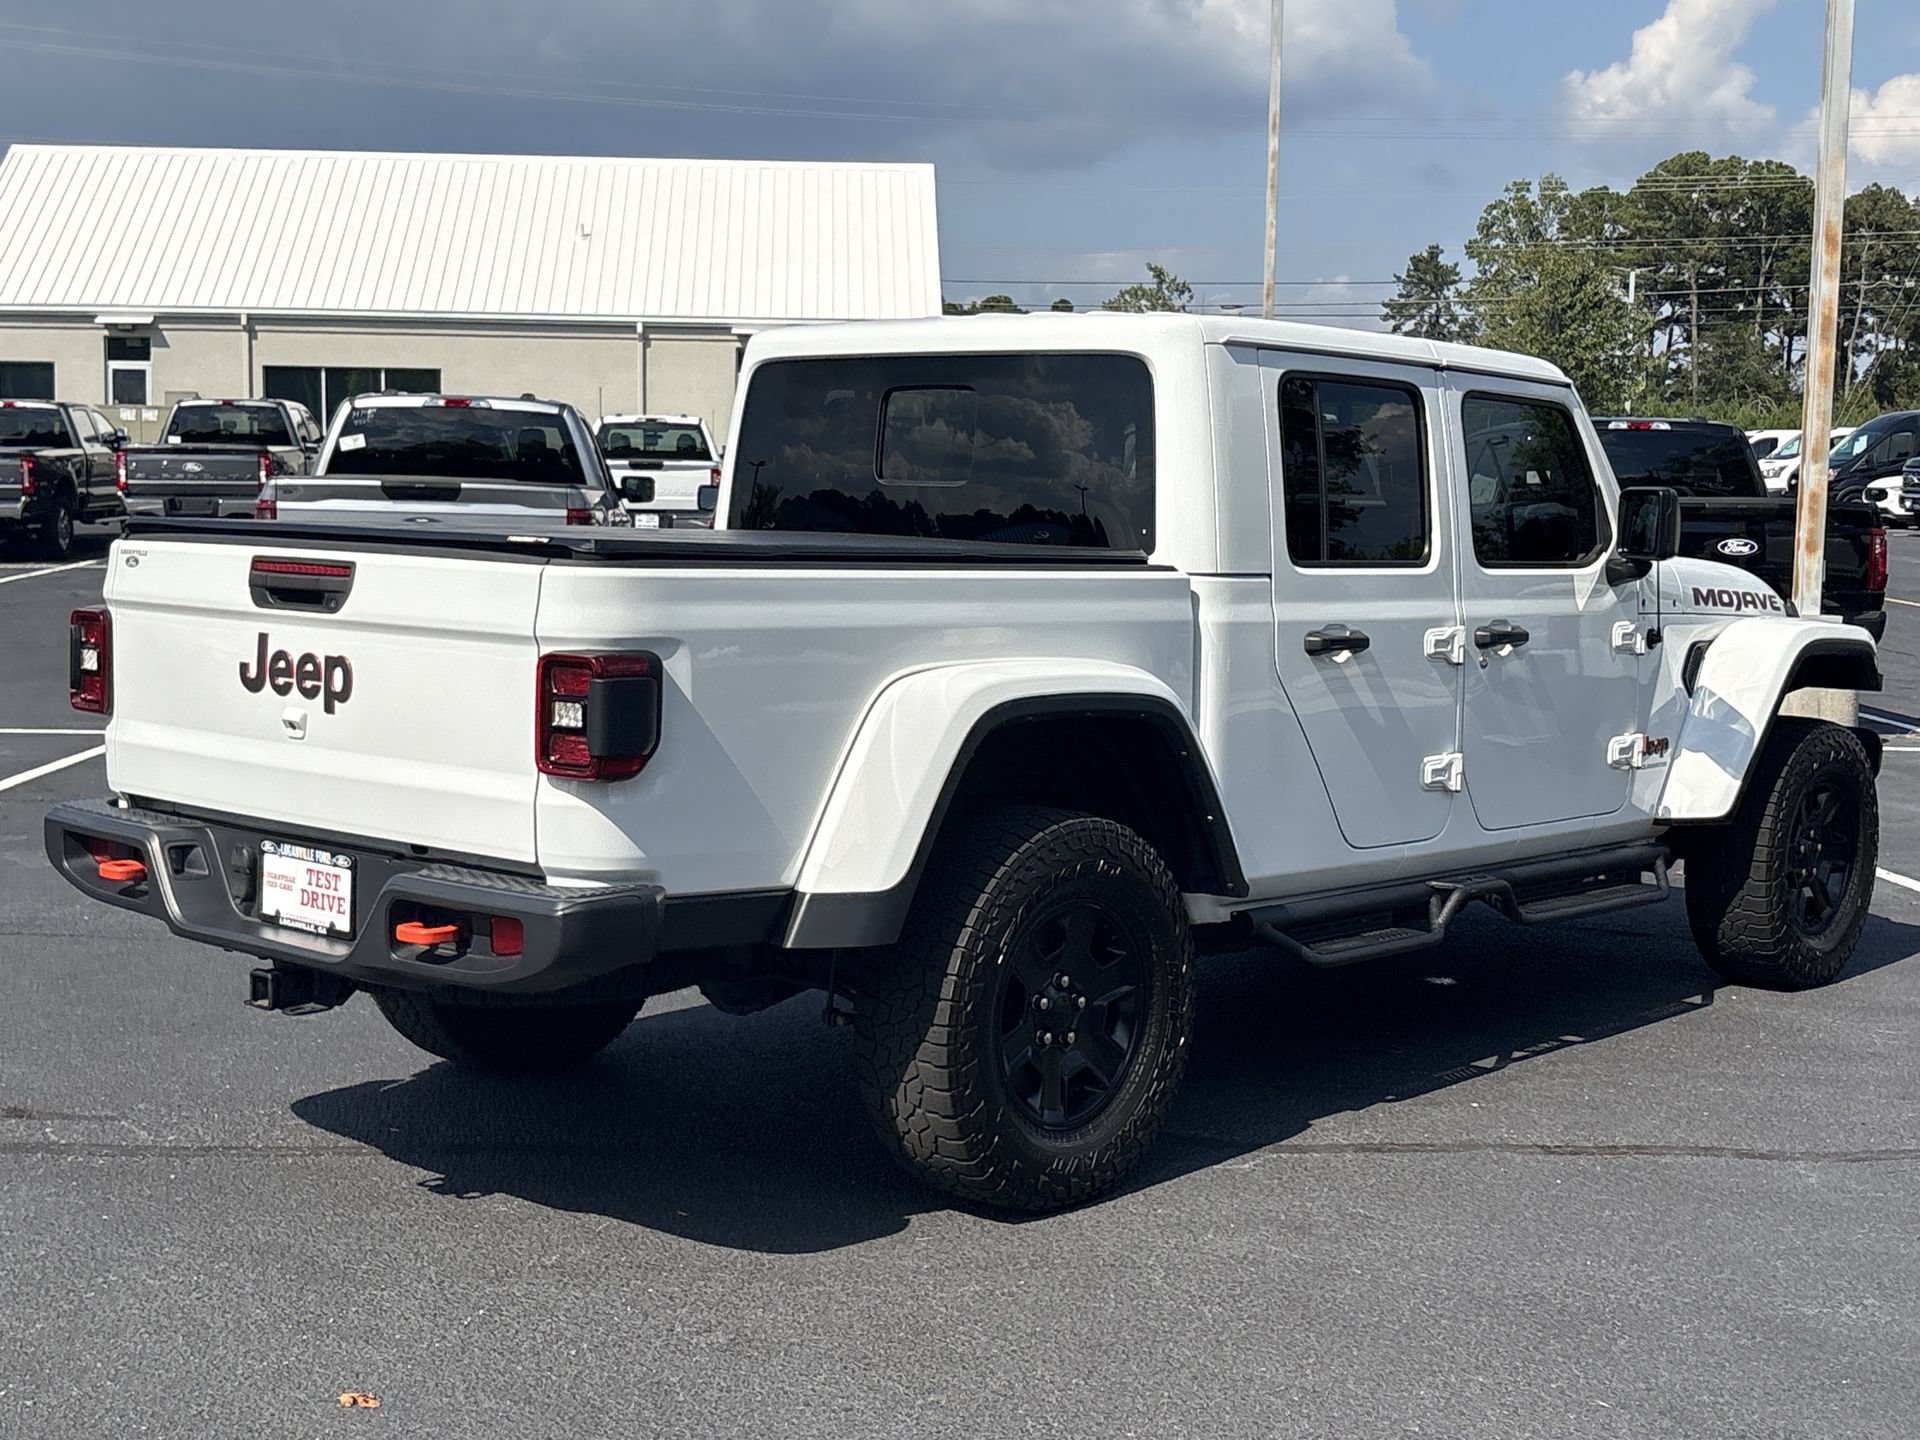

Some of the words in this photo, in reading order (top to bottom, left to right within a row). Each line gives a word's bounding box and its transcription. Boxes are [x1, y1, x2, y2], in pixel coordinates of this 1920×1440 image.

[1691, 587, 1782, 612] MOJAVE
[238, 631, 354, 716] Jeep
[306, 868, 341, 892] TEST
[300, 888, 345, 914] DRIVE
